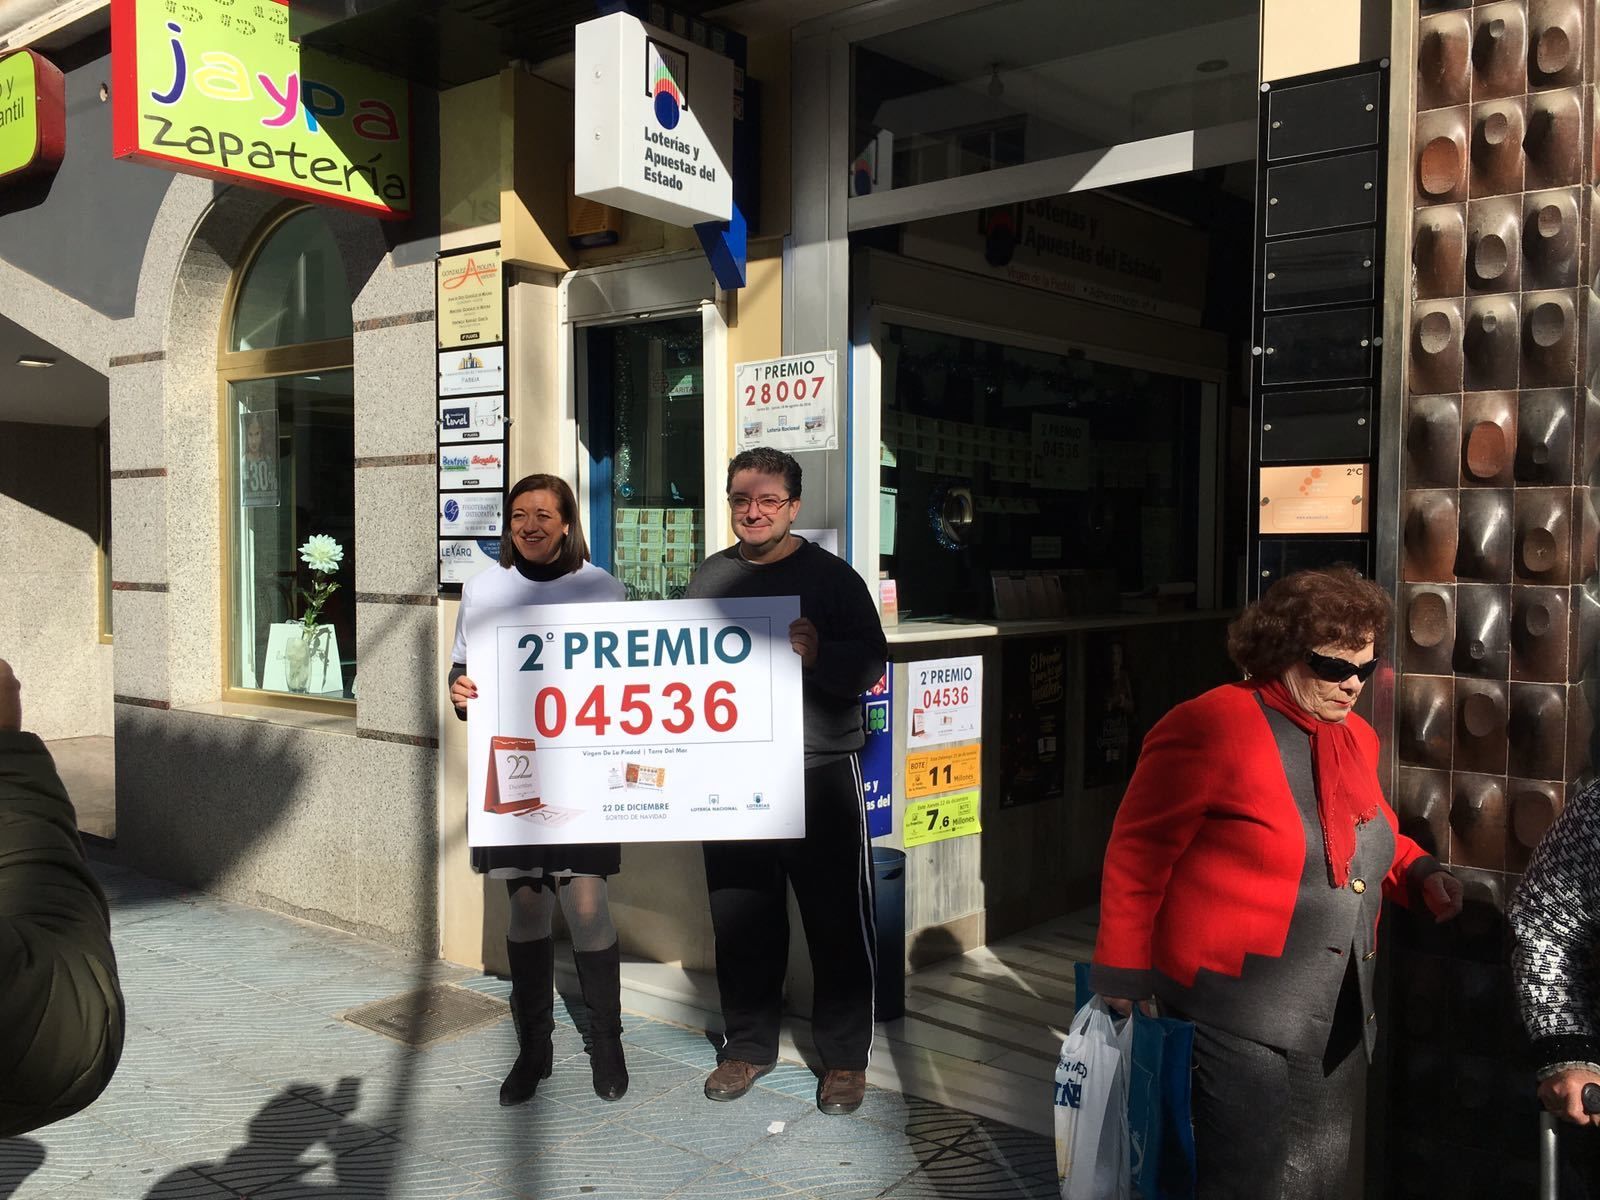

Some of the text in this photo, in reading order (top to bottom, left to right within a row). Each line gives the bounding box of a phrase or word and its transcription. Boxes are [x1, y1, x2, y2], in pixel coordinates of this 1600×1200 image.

[151, 22, 400, 141] jaypa
[644, 126, 700, 161] Loterías y
[144, 114, 407, 200] zapatería
[645, 147, 716, 182] Apuestas del
[644, 167, 683, 191] Estado
[1024, 225, 1091, 264] Apuestas
[765, 360, 815, 380] PREMIO
[745, 377, 825, 406] 28007
[250, 461, 278, 491] 30%
[442, 542, 472, 557] LEXARQ
[518, 625, 752, 672] 2º PREMIO
[930, 667, 972, 684] PREMIO
[534, 680, 738, 738] 04536
[924, 686, 968, 709] 04536
[506, 754, 532, 780] 22
[929, 764, 952, 787] 11
[873, 779, 879, 793] y
[627, 803, 669, 811] DICIEMBRE
[877, 794, 890, 808] del
[952, 816, 974, 826] Millones
